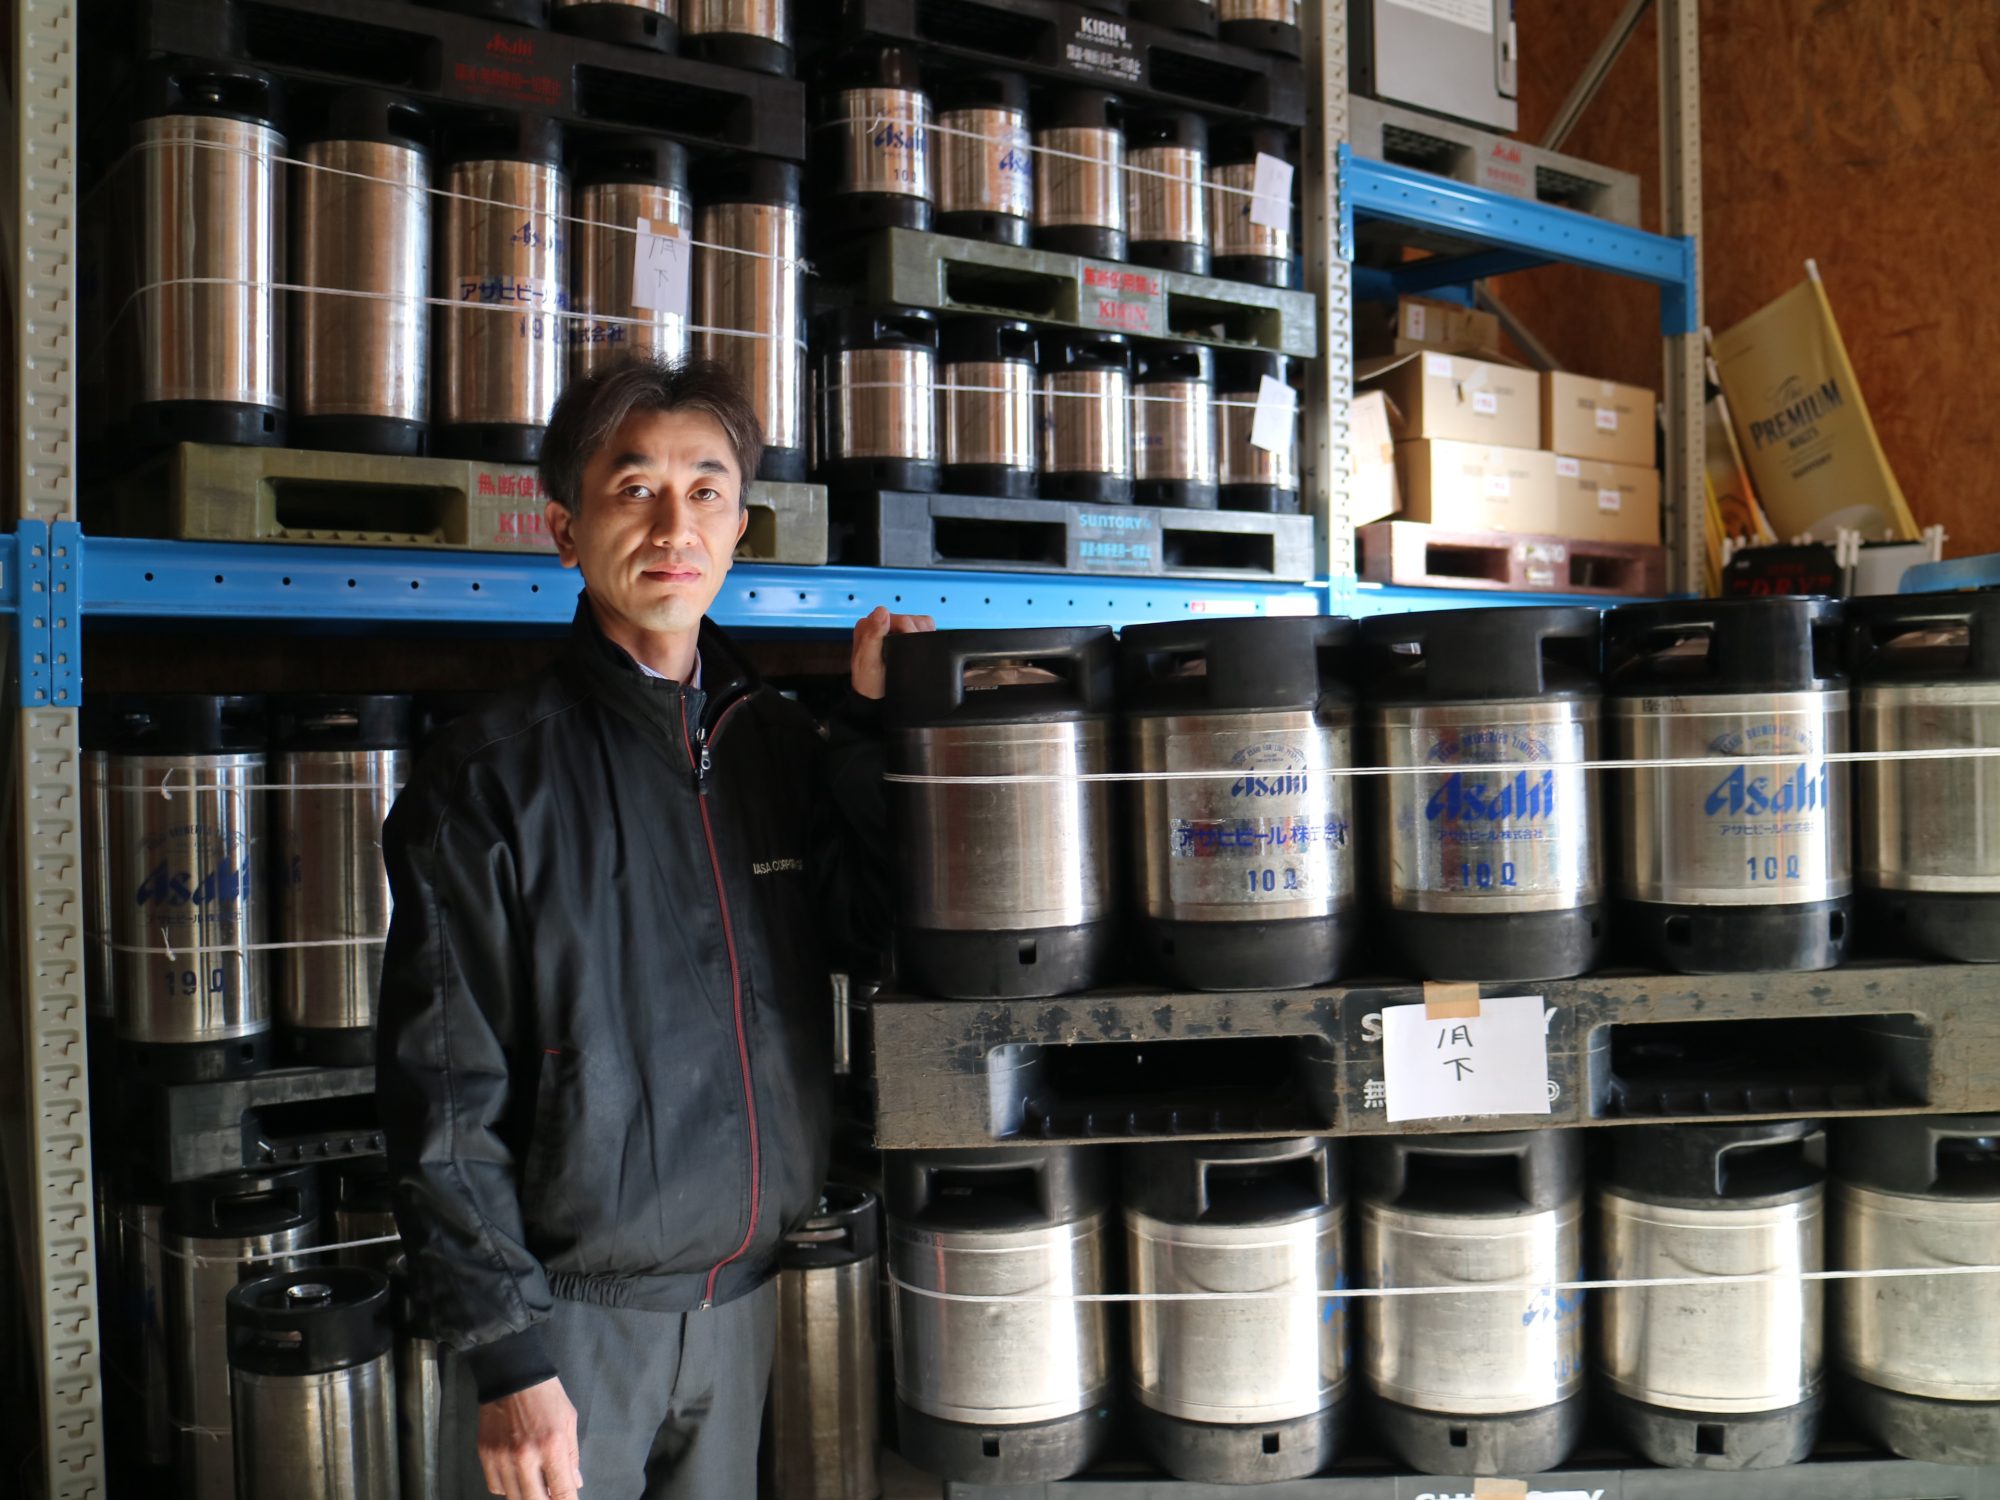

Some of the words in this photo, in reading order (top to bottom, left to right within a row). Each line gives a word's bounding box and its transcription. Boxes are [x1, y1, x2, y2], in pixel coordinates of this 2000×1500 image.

[1081, 16, 1127, 42] KIRIN
[1748, 377, 1844, 450] PREMIUM
[1080, 513, 1142, 529] SUNTORY
[1231, 764, 1308, 798] Asahi
[1425, 769, 1553, 822] Asahi
[1704, 762, 1829, 817] Asahi
[136, 855, 249, 907] Asahi
[1437, 1024, 1474, 1049] 1月
[1443, 1057, 1475, 1081] 下
